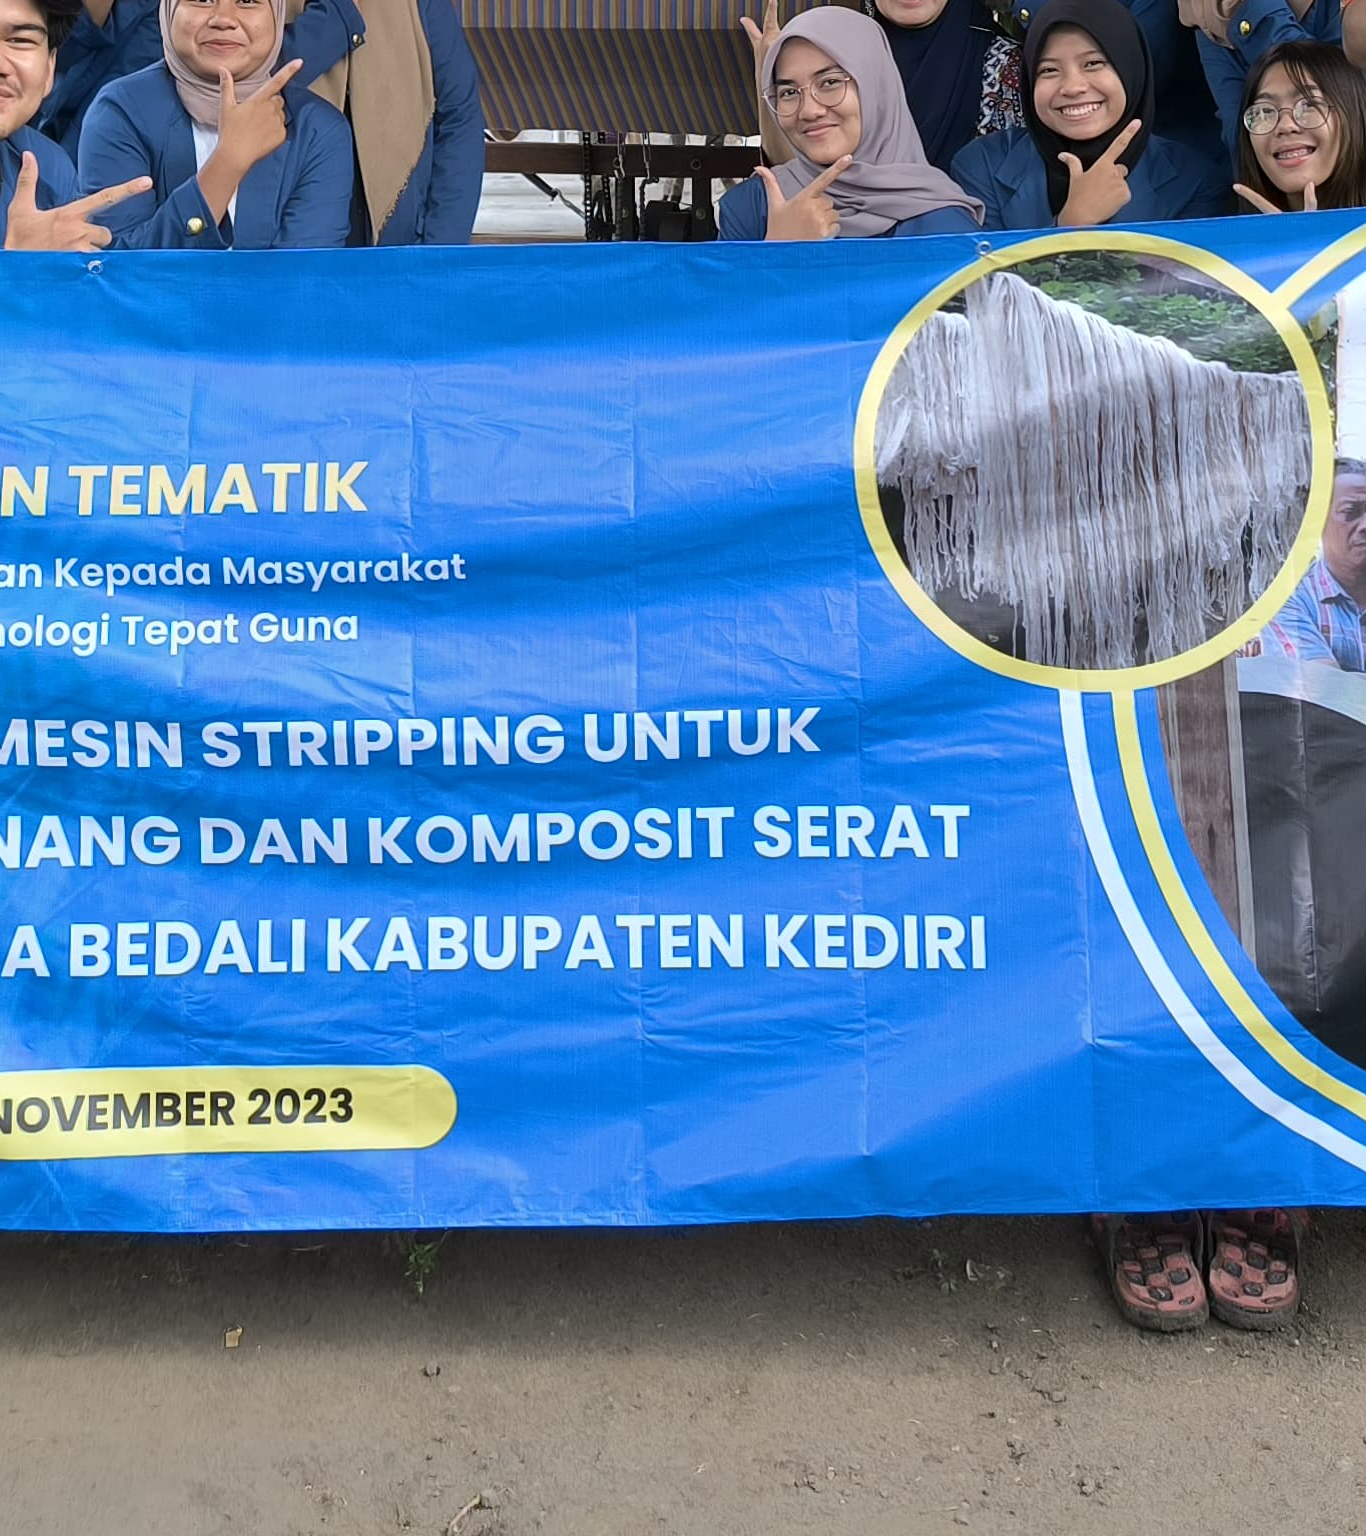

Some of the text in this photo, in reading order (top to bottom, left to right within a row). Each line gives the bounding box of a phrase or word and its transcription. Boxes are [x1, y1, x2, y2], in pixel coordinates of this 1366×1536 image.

[68, 460, 369, 517] TEMATIK
[54, 555, 211, 596] Kepada
[223, 552, 467, 592] Masyarakat
[121, 612, 238, 654] Tepat
[249, 613, 359, 644] Guna
[203, 714, 565, 768] STRIPPING
[583, 707, 821, 762] UNTUK
[200, 817, 348, 866] DAN
[368, 807, 735, 866] KOMPOSIT
[753, 804, 971, 859] SERAT
[69, 919, 307, 978] BEDALI
[326, 914, 744, 973] KABUPATEN
[764, 914, 988, 971] KEDIRI
[248, 1088, 355, 1126] 2023
